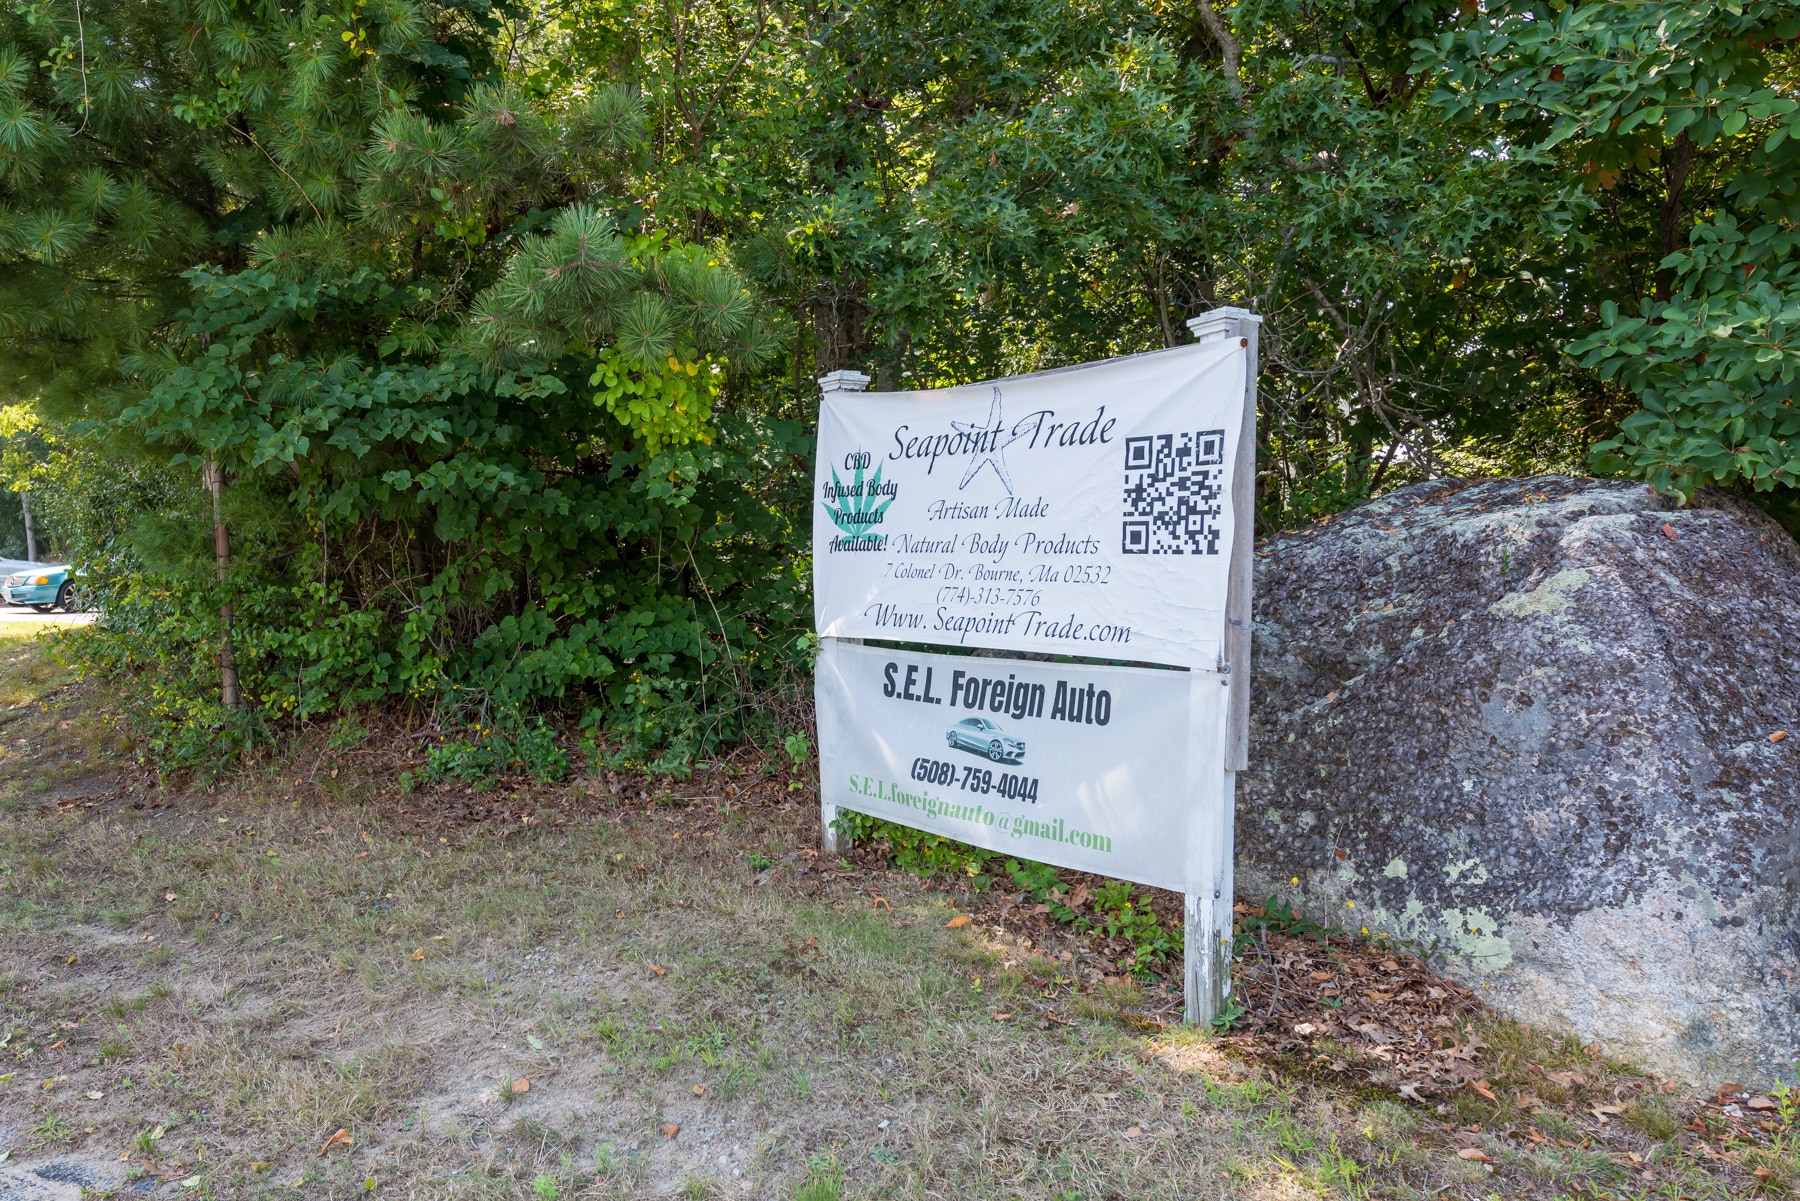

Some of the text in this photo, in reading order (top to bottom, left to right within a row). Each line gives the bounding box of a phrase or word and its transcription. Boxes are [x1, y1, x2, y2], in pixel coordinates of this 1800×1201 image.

[888, 405, 1116, 474] Seapoint Trade
[844, 452, 871, 471] CBD
[823, 480, 898, 501] Infused Body
[833, 508, 884, 526] Products
[928, 497, 1049, 521] Artisan Made
[829, 534, 887, 554] Available!
[893, 532, 1100, 563] Natural Body Products
[883, 563, 1111, 585] 7 Colonel Dr. Bourne, Ma 02532
[936, 586, 1040, 607] (774)-313-7576
[883, 662, 1112, 726] S.E.L. Foreign Auto
[910, 757, 1039, 804] (508)-759-4044
[849, 774, 1112, 852] S.E.L.foreignauto@gmail.com
